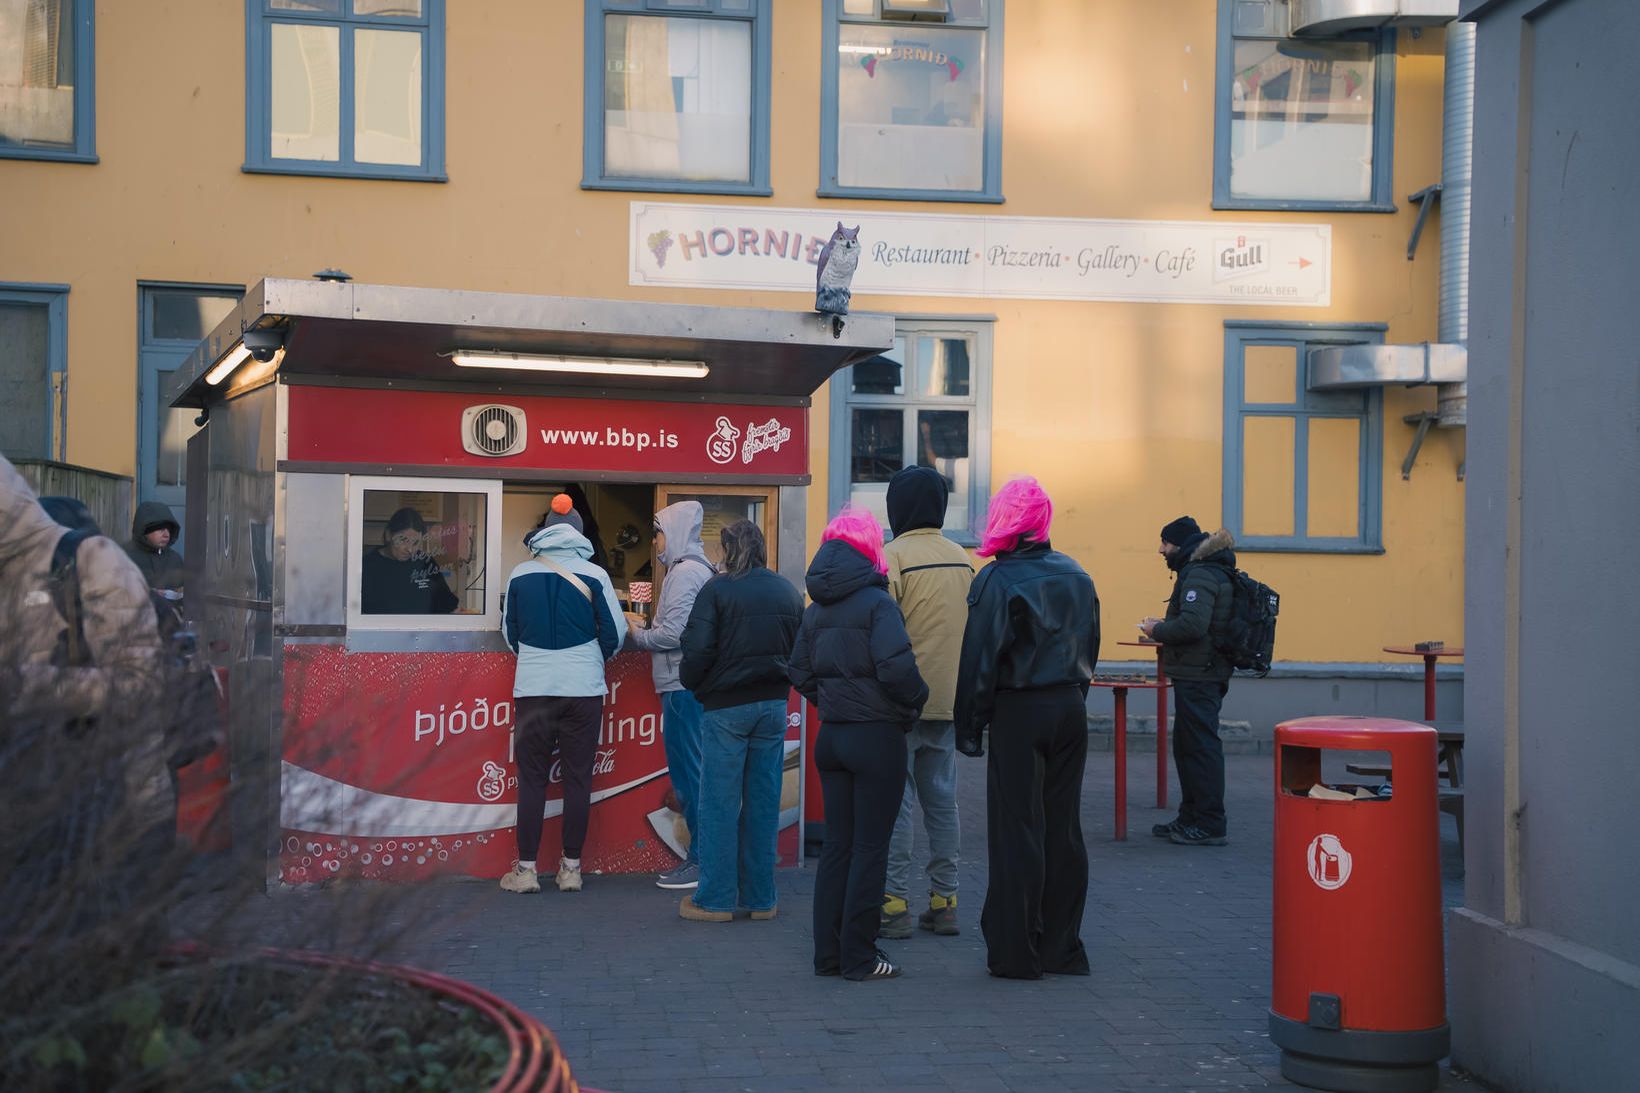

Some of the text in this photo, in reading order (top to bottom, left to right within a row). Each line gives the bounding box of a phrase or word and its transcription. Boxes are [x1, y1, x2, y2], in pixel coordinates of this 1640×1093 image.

[871, 240, 972, 266] Restaurant
[987, 244, 1061, 267] Pizzeria
[1076, 245, 1141, 278] Gallery
[1155, 246, 1195, 279] Café
[1220, 244, 1263, 269] Gull
[1229, 285, 1298, 297] THE LOCAL BEER
[540, 427, 679, 451] www.bbp.is
[712, 441, 731, 458] SS
